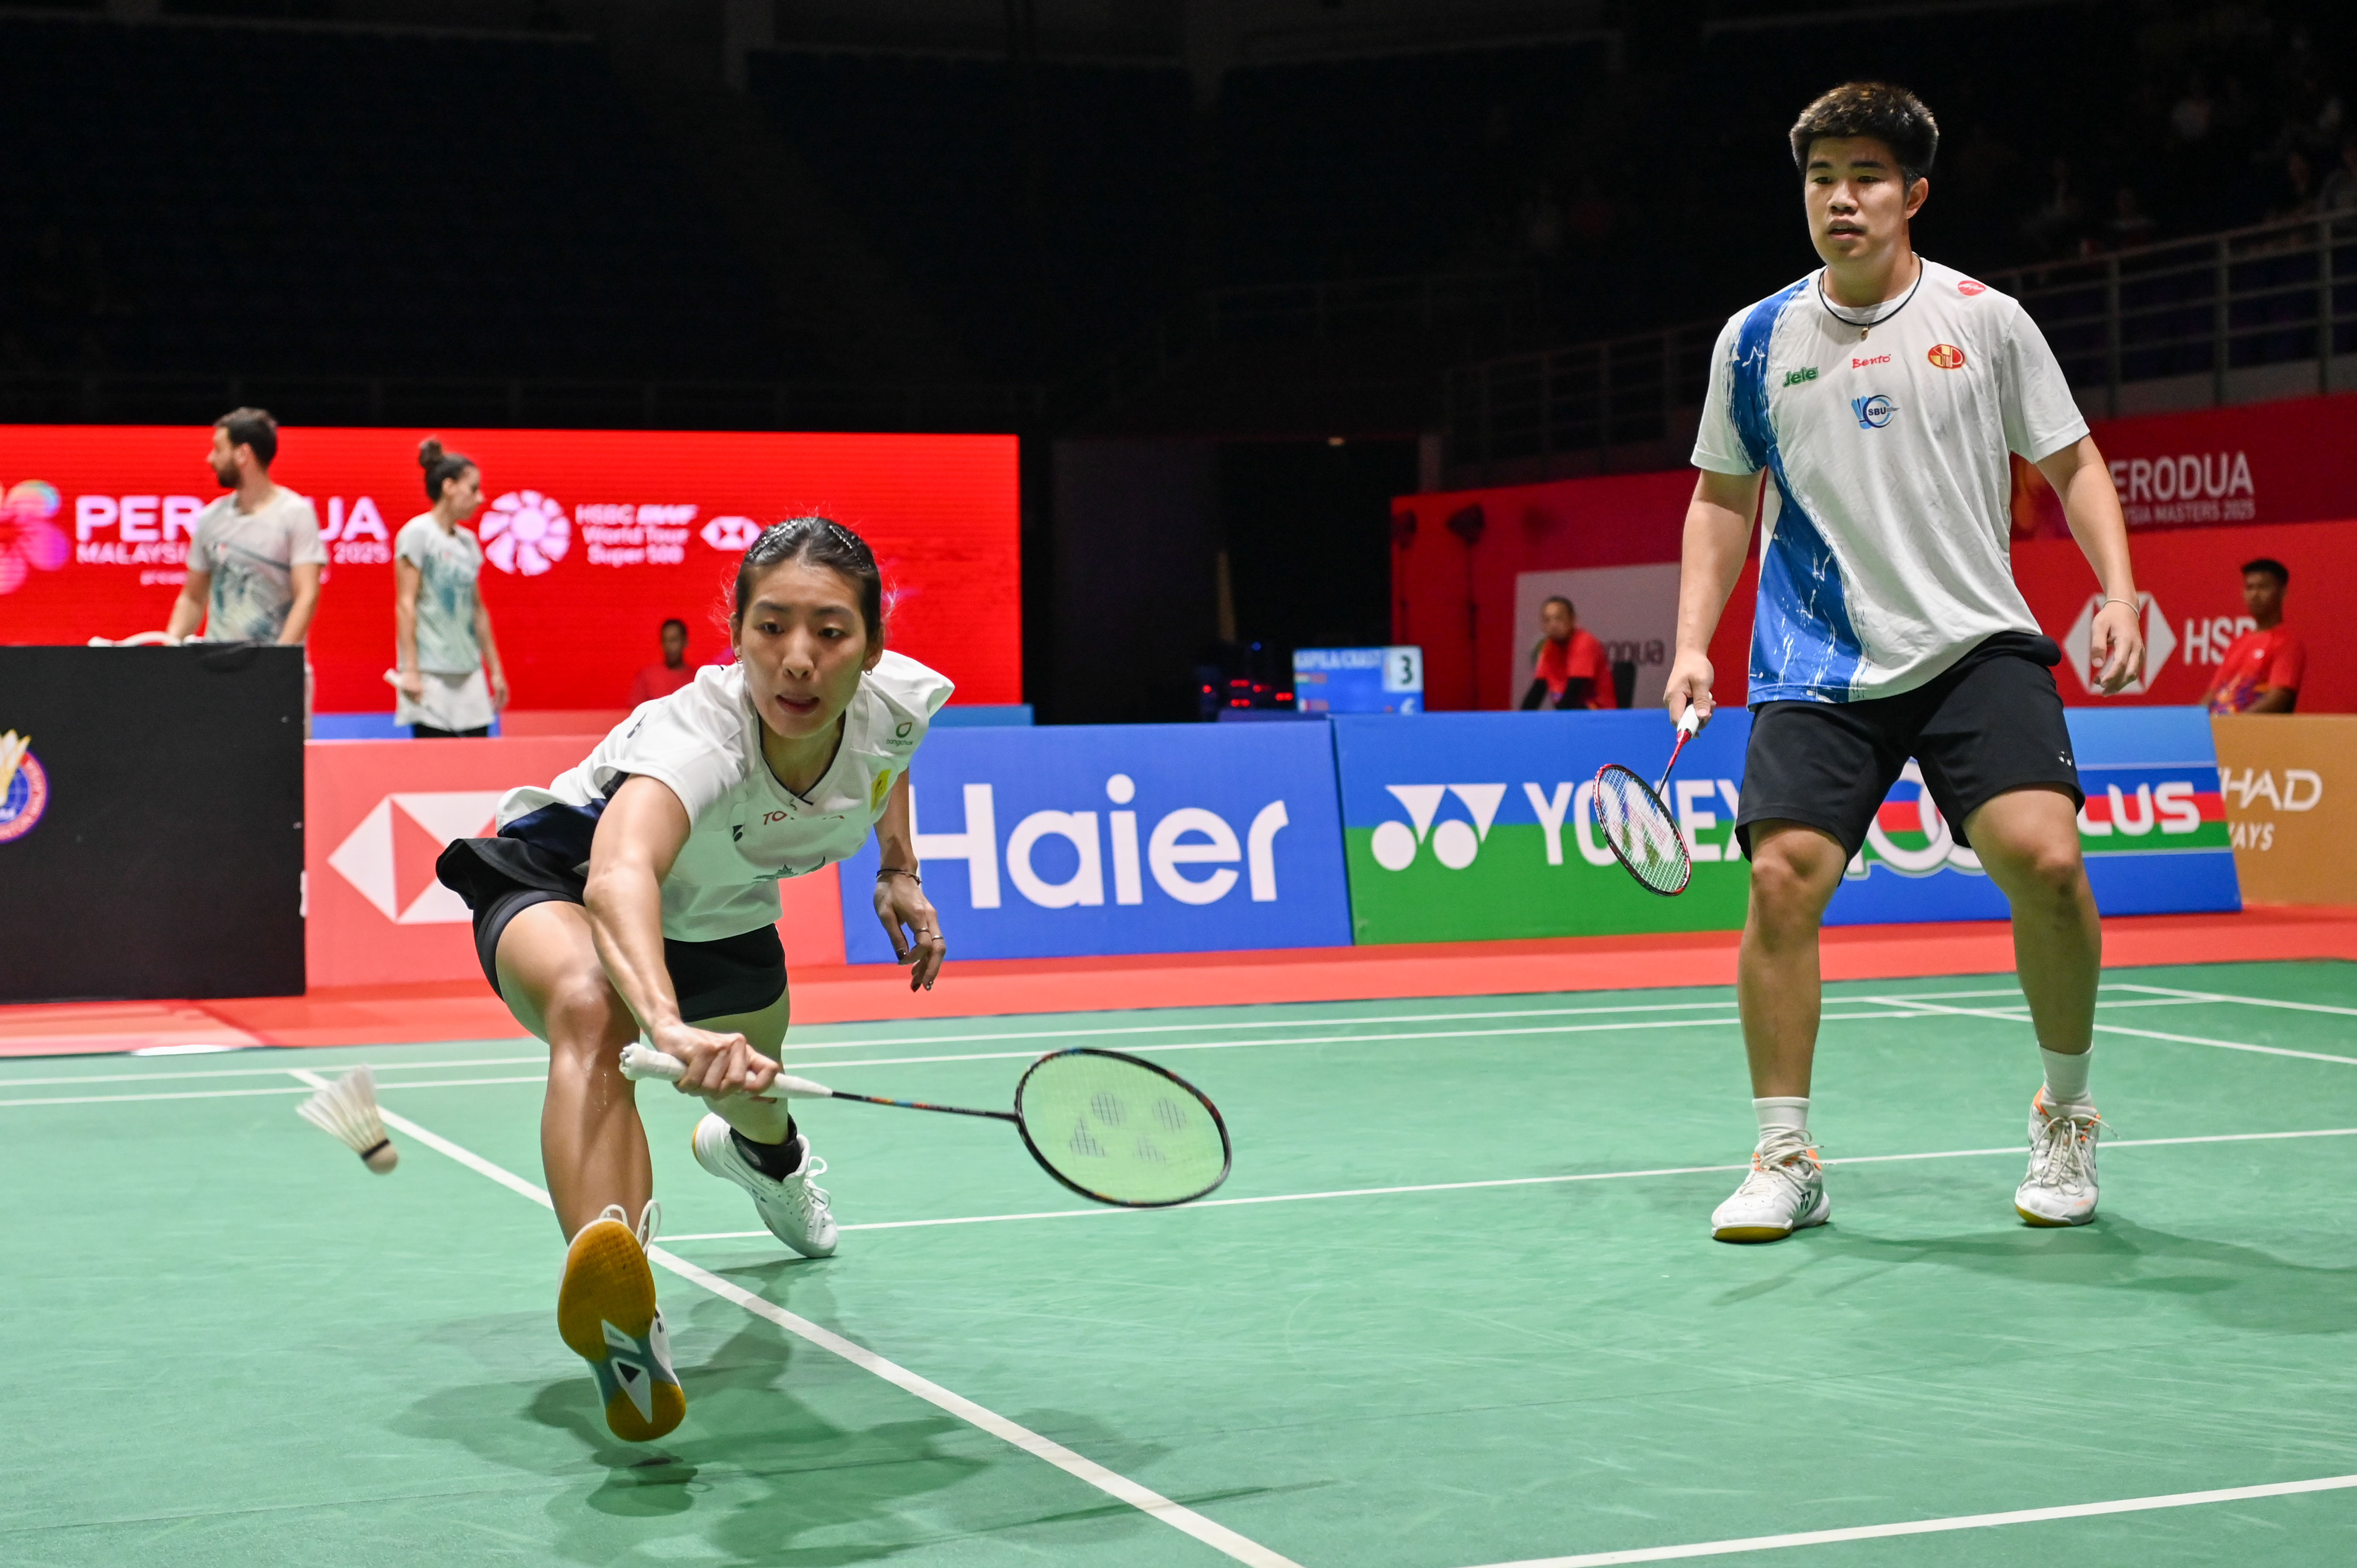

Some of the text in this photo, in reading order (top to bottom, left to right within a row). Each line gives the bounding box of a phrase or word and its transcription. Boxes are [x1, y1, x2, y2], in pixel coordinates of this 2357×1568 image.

[1852, 355, 1891, 369] Bento
[1783, 367, 1819, 388] Jele
[1868, 407, 1886, 416] SBU
[2109, 450, 2255, 504] ERODUA
[75, 494, 389, 542] PERUA
[575, 503, 636, 525] HSBC
[581, 524, 691, 546] World Tour
[76, 541, 392, 564] MALAYSI 2025
[587, 543, 685, 569] Super 500
[2184, 616, 2258, 666] HS
[2219, 767, 2323, 812] HAD
[908, 773, 1289, 909] Haier
